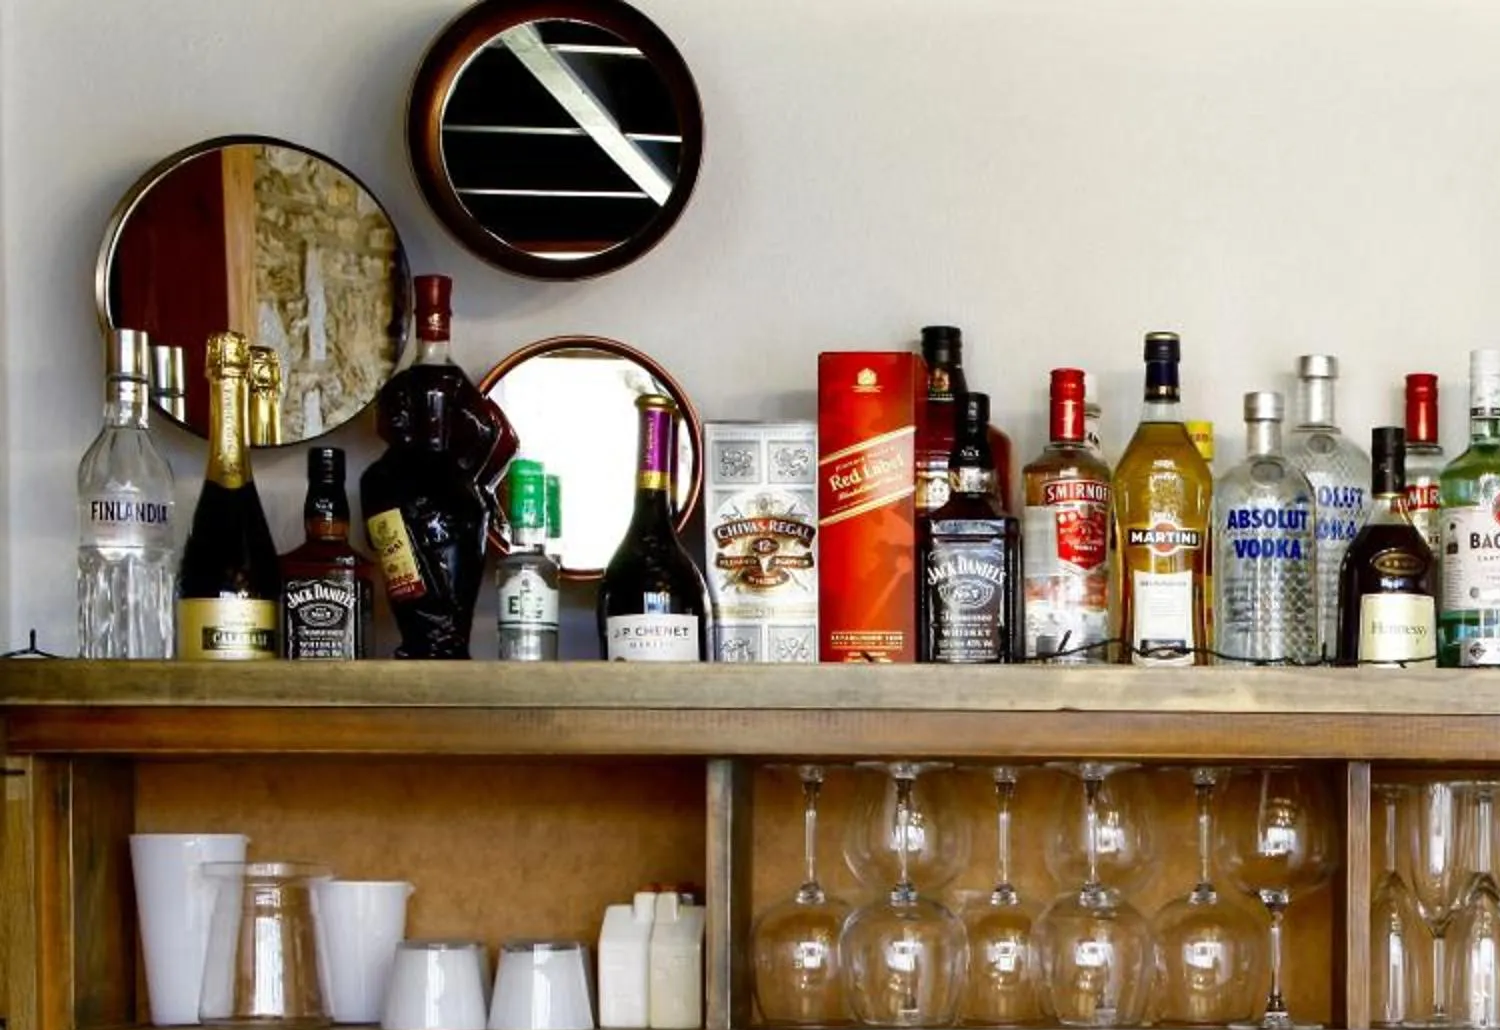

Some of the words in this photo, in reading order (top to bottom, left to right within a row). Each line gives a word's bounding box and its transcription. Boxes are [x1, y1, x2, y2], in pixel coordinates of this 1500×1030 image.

[829, 467, 862, 492] Red
[1227, 508, 1309, 531] ABSOLUT
[717, 522, 766, 539] CHIVAS
[769, 520, 810, 541] REGAL
[1131, 531, 1198, 544] MARTINI
[1234, 538, 1302, 559] VODKA
[928, 562, 957, 586] JACK
[287, 589, 314, 610] JACK
